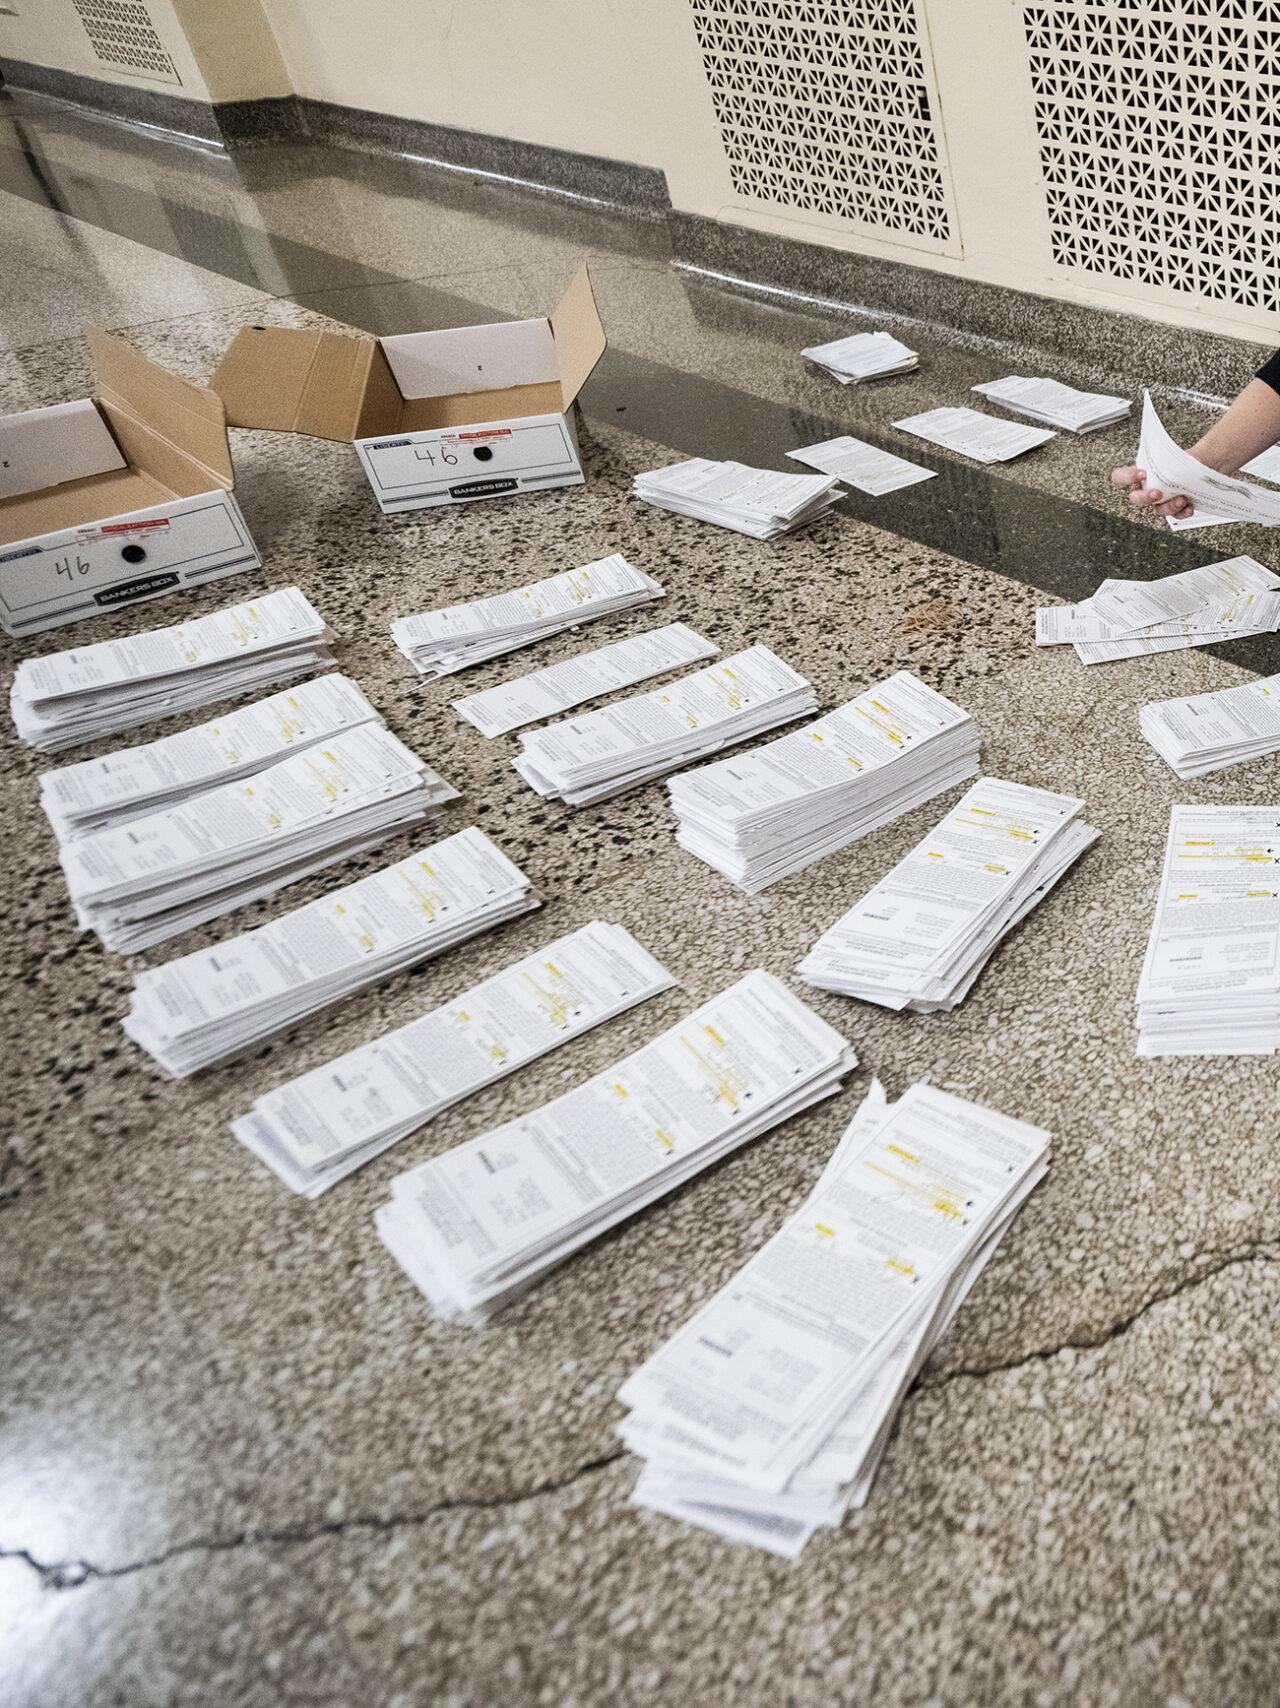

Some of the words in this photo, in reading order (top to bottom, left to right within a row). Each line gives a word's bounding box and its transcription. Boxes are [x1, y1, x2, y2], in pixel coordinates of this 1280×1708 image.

[453, 483, 493, 496] BANKERS
[494, 480, 514, 490] BOX
[55, 556, 90, 581] 46
[100, 583, 151, 602] BANKERS
[151, 576, 174, 588] BOX
